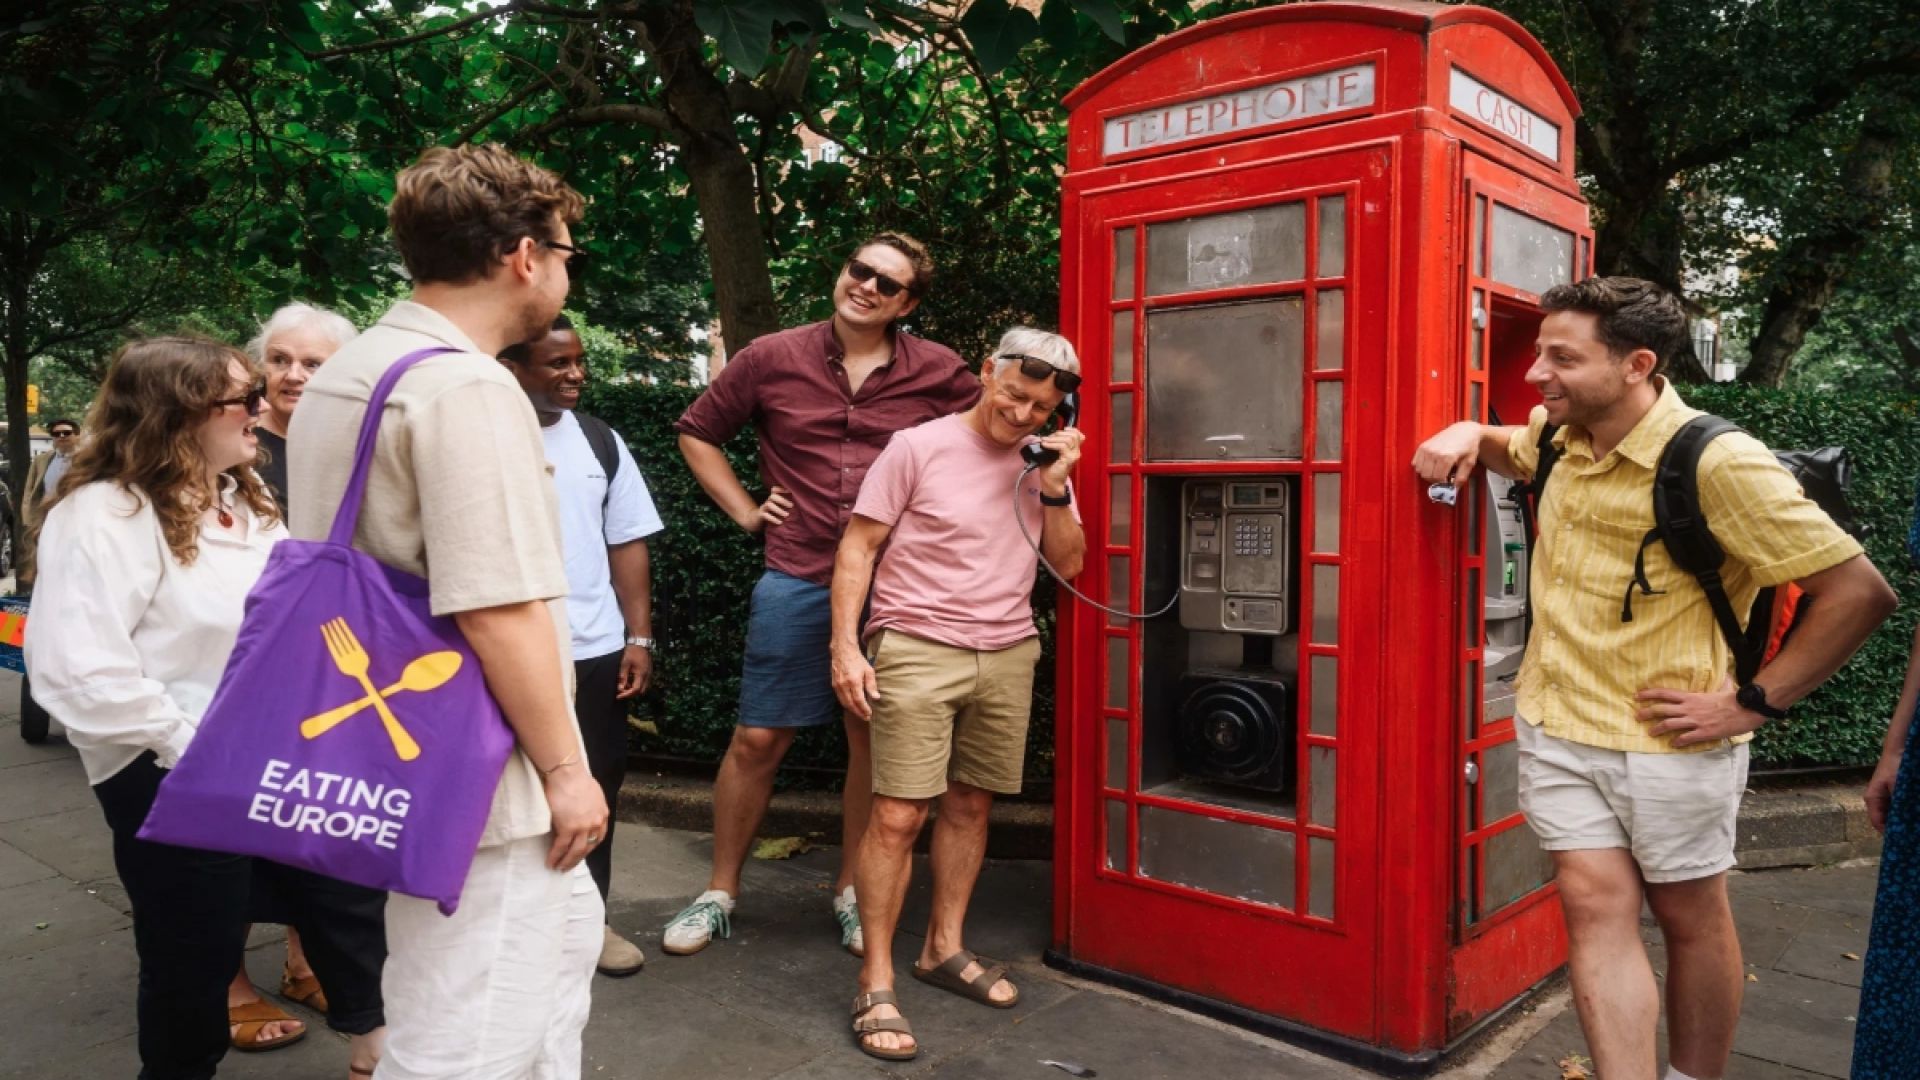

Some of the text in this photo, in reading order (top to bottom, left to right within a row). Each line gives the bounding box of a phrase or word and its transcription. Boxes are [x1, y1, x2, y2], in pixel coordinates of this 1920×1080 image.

[1117, 72, 1360, 147] TELEPHONE
[1476, 88, 1532, 144] CASH
[260, 758, 411, 817] EATING
[248, 792, 403, 849] EUROPE
